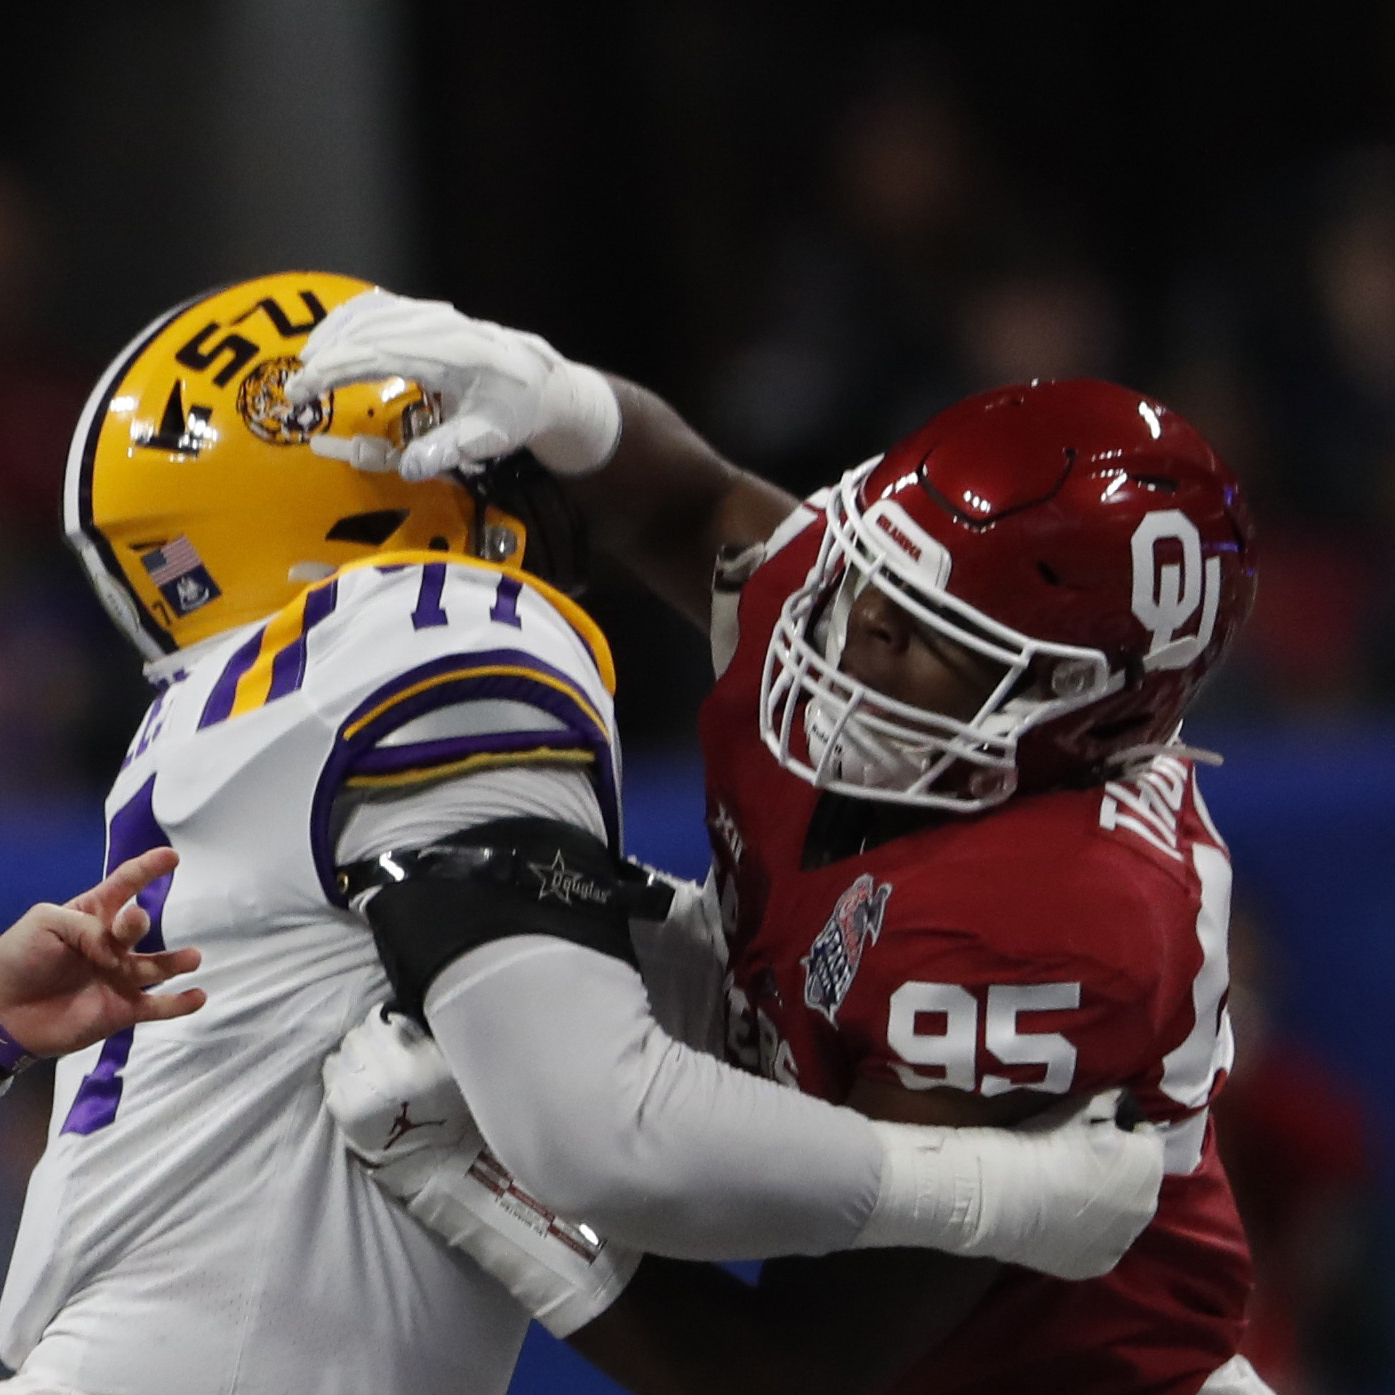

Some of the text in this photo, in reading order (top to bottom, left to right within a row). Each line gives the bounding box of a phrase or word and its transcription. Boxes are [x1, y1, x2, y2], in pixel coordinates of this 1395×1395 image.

[135, 290, 328, 458] LSU
[1130, 508, 1221, 670] OU
[886, 980, 1082, 1096] 95
